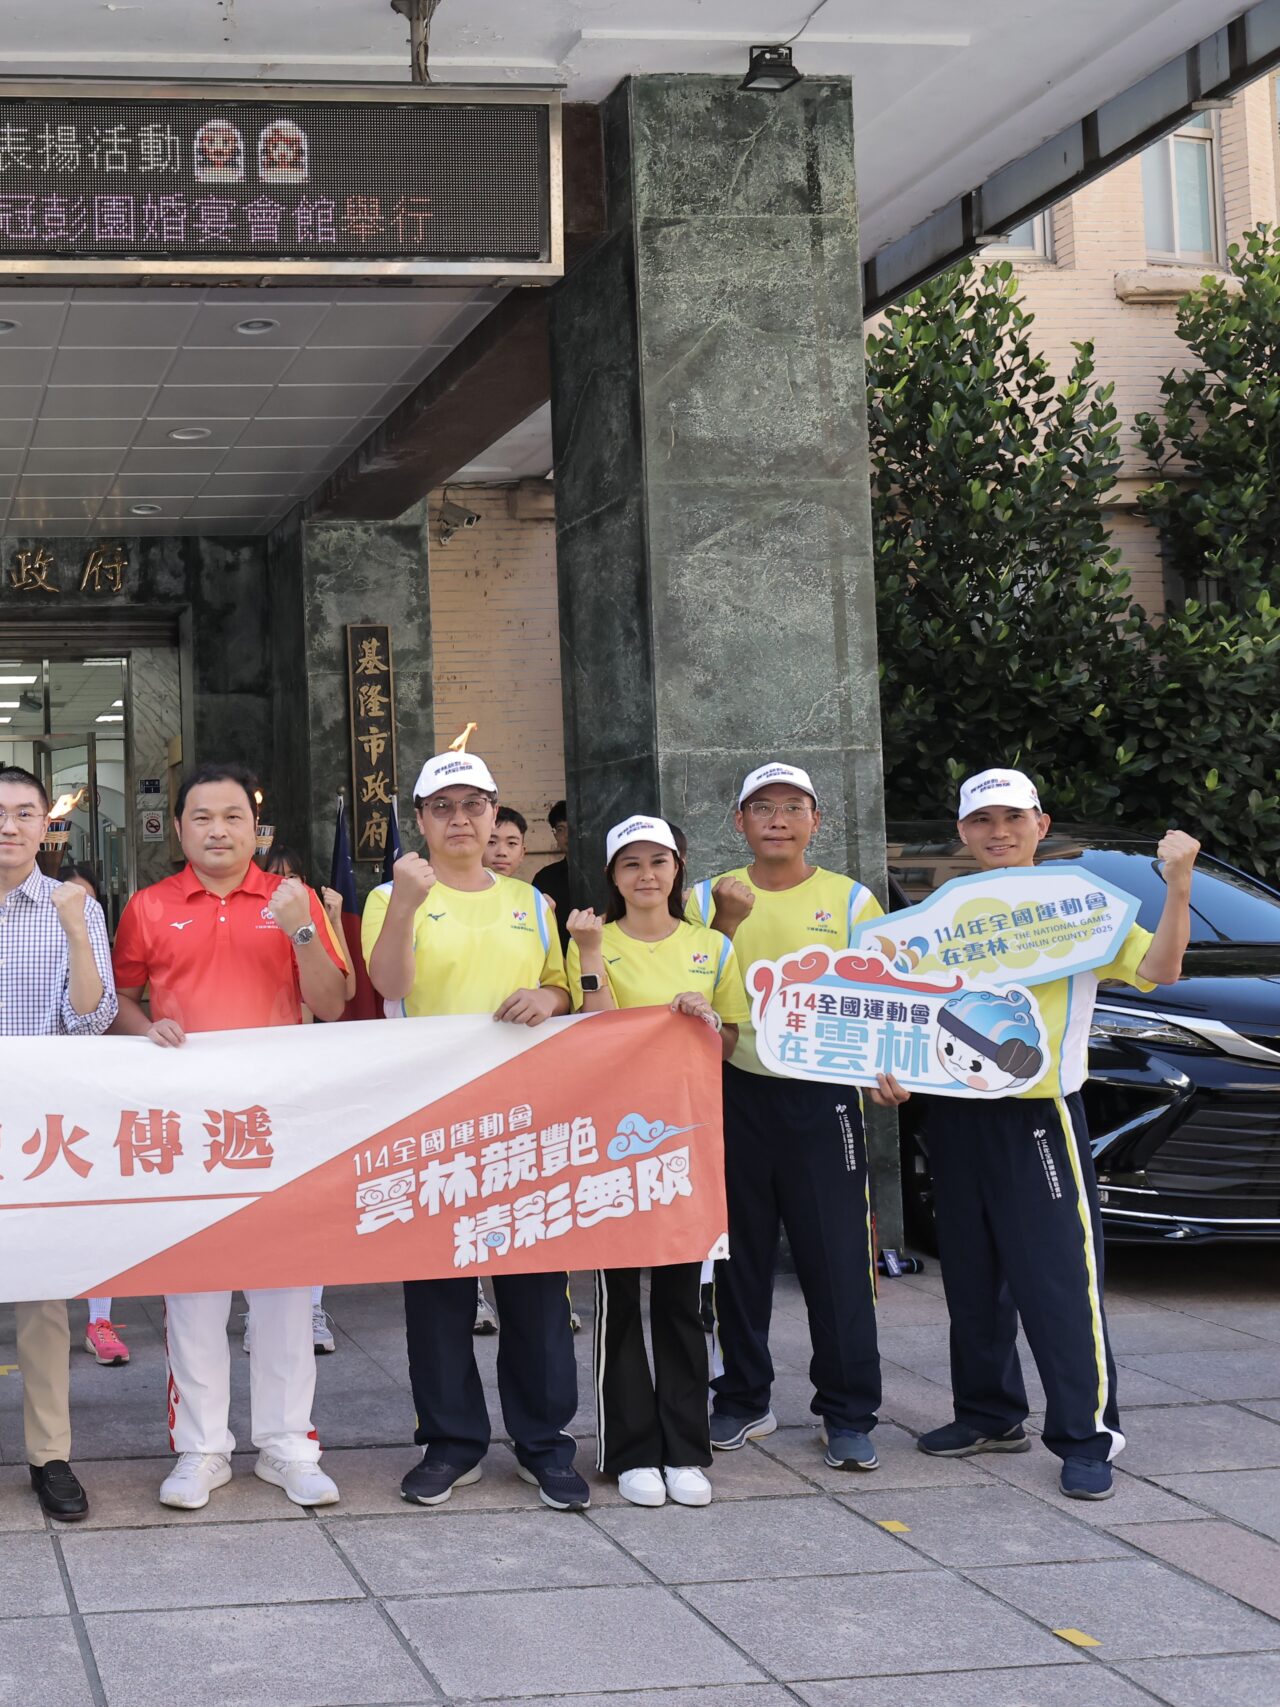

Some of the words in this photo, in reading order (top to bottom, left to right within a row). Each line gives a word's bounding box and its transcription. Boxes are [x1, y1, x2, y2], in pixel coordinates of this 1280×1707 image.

[355, 637, 391, 849] 基隆市政府
[934, 891, 1109, 943] 114年全國運動會
[1013, 931, 1031, 941] THE
[1033, 921, 1077, 937] NATIONAL
[1080, 913, 1112, 926] GAMES
[1016, 939, 1050, 951] YUNLIN
[1052, 930, 1088, 944] COUNTY
[1091, 924, 1113, 936] 2025
[940, 937, 1009, 966] 在雲林
[352, 1103, 533, 1176] 114全國運動會
[453, 1145, 693, 1269] 精彩無限
